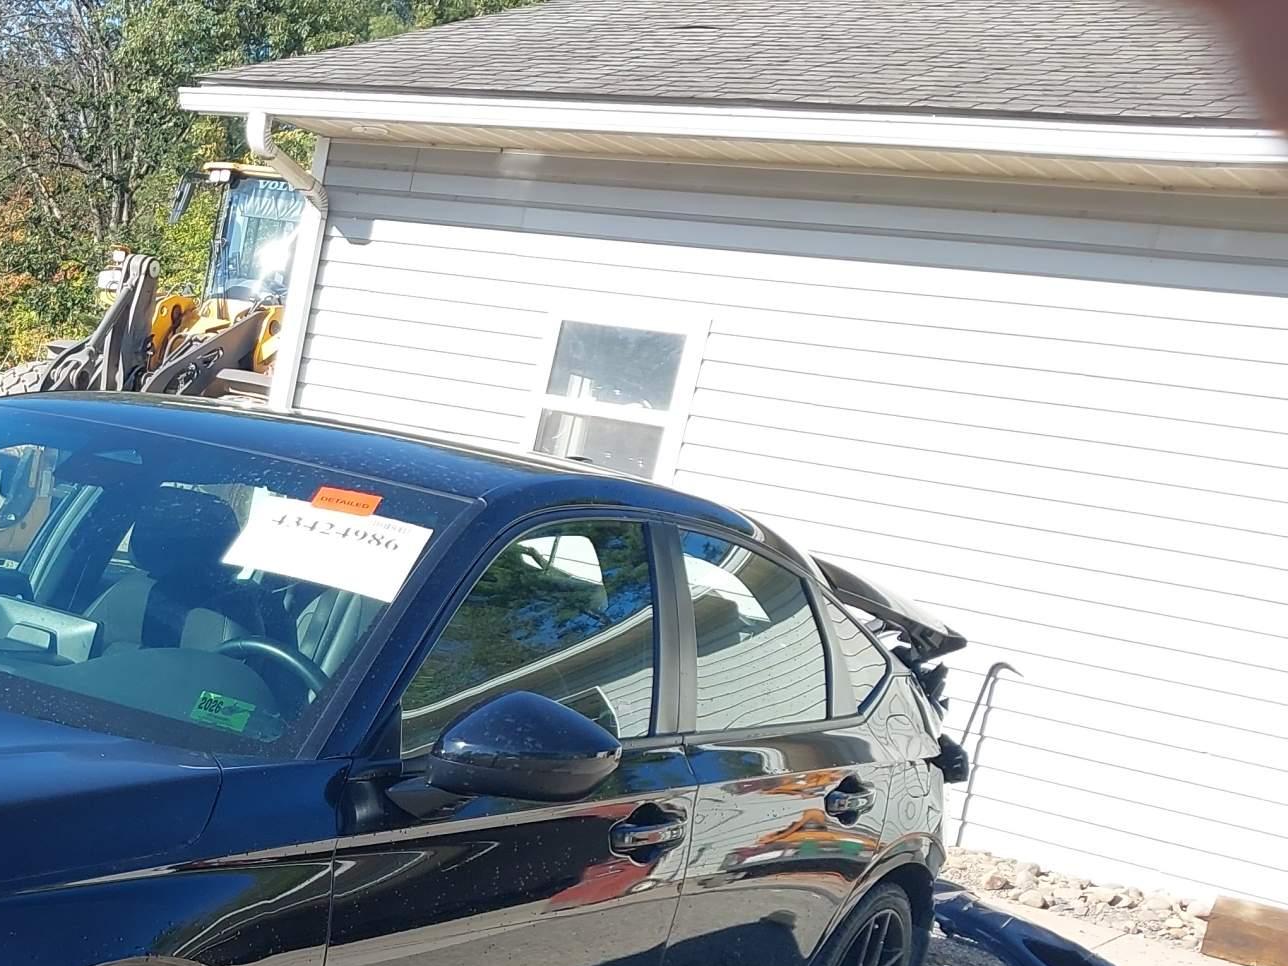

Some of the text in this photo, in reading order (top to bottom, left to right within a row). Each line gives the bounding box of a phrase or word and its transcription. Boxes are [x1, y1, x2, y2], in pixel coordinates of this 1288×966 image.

[320, 496, 370, 509] DETAILED
[272, 514, 399, 550] 43424986
[198, 696, 224, 714] 2026
